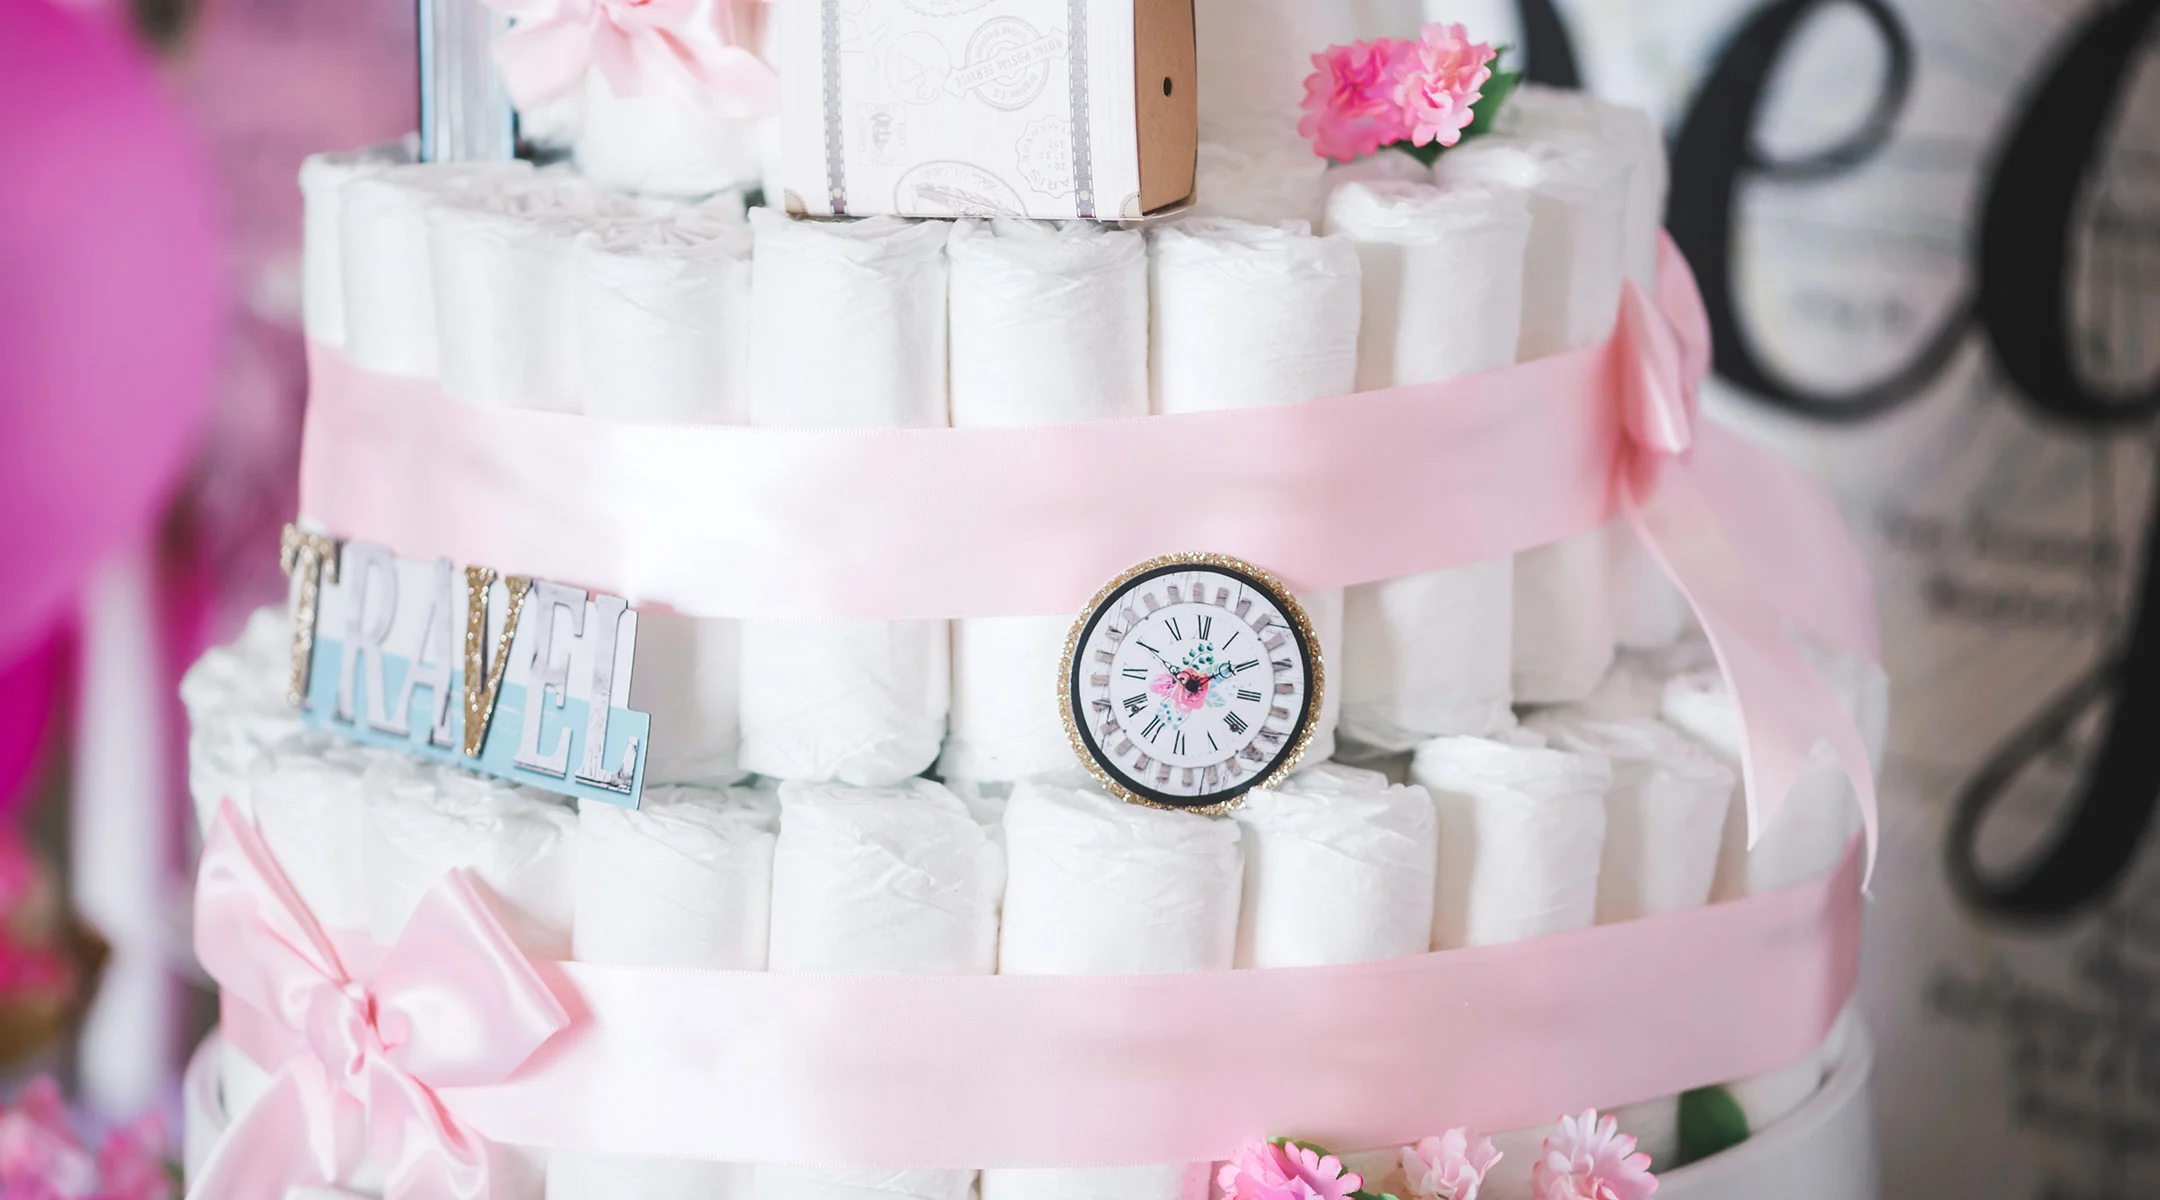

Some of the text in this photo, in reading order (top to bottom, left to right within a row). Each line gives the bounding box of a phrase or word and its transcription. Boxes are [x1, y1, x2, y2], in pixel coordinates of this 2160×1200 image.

[954, 37, 1063, 89] ROYAL POSTAL SERVICE
[1029, 169, 1070, 190] ARIS
[280, 523, 640, 794] TRAVEL
[1236, 689, 1262, 702] III
